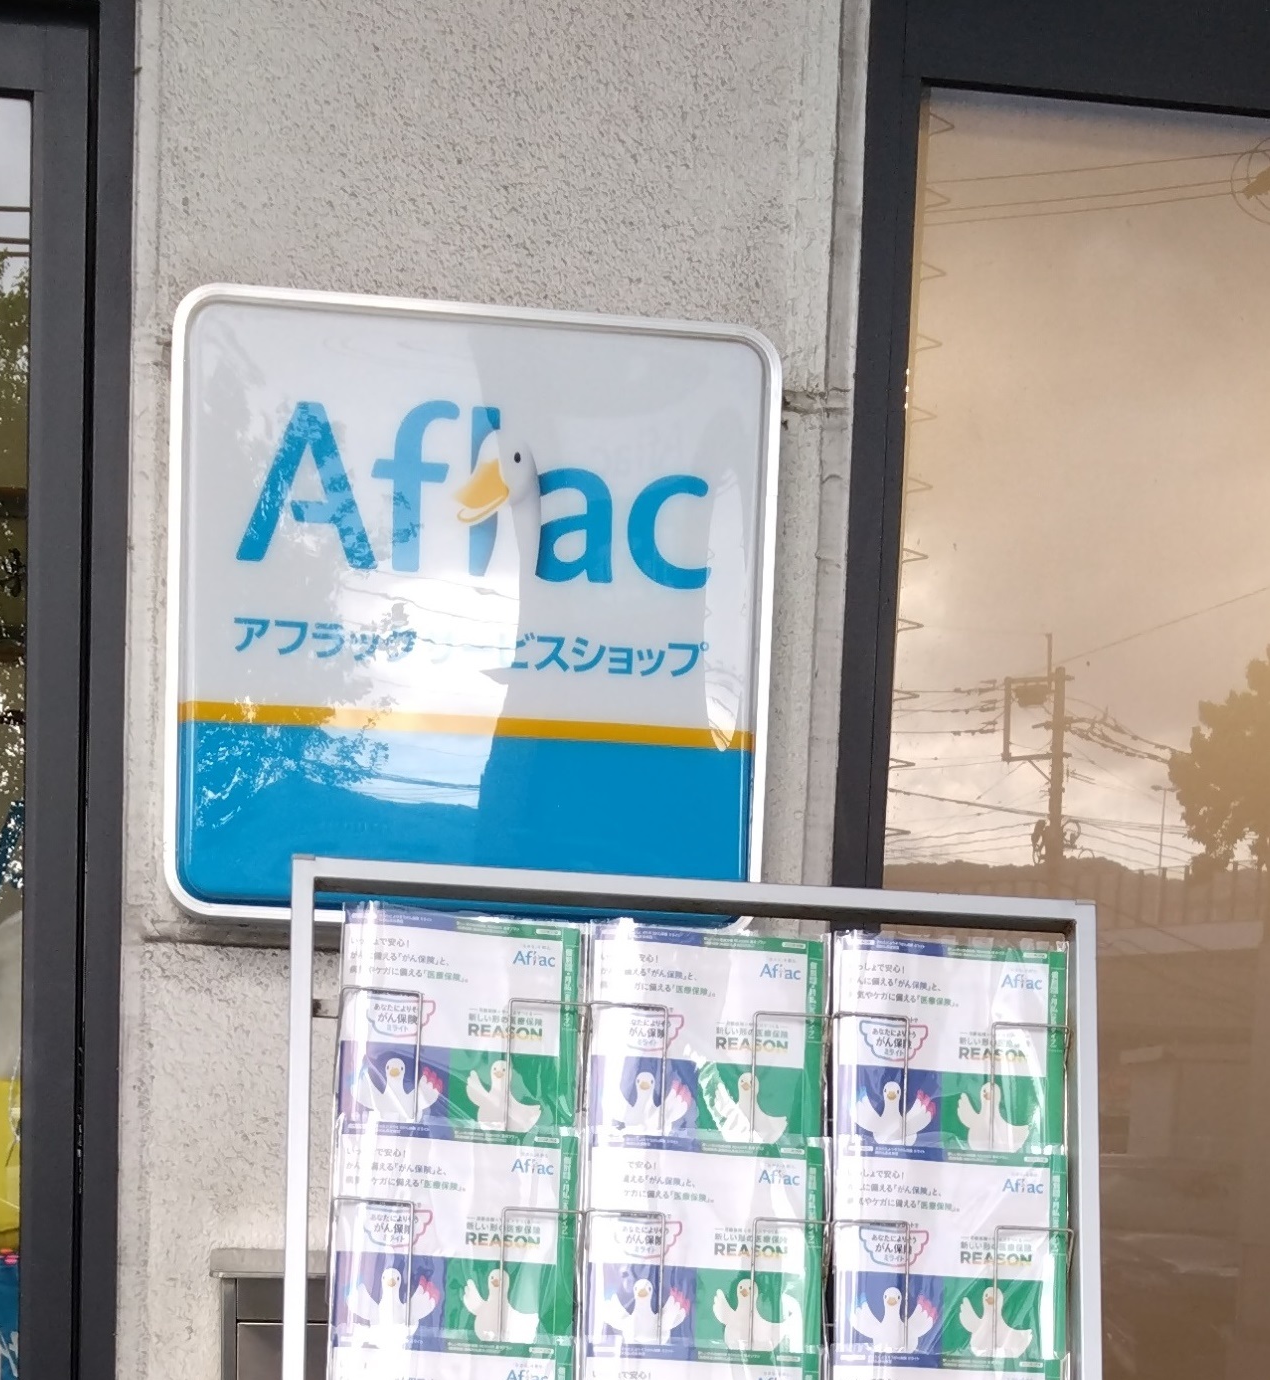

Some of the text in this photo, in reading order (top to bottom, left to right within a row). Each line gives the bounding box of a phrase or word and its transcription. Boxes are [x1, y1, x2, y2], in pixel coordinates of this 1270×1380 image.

[236, 400, 711, 589] Aflac
[856, 977, 941, 992] んに備える「がん保険」と、
[856, 990, 959, 1008] 気やケガに備える「医療保険」。
[374, 1003, 419, 1013] あなたによりそ
[378, 1013, 418, 1025] がん保険
[468, 1023, 542, 1041] REASON
[716, 1036, 788, 1053] REASON
[466, 1231, 541, 1249] REASON
[714, 1242, 788, 1259] REASON
[960, 1251, 1033, 1267] REASON
